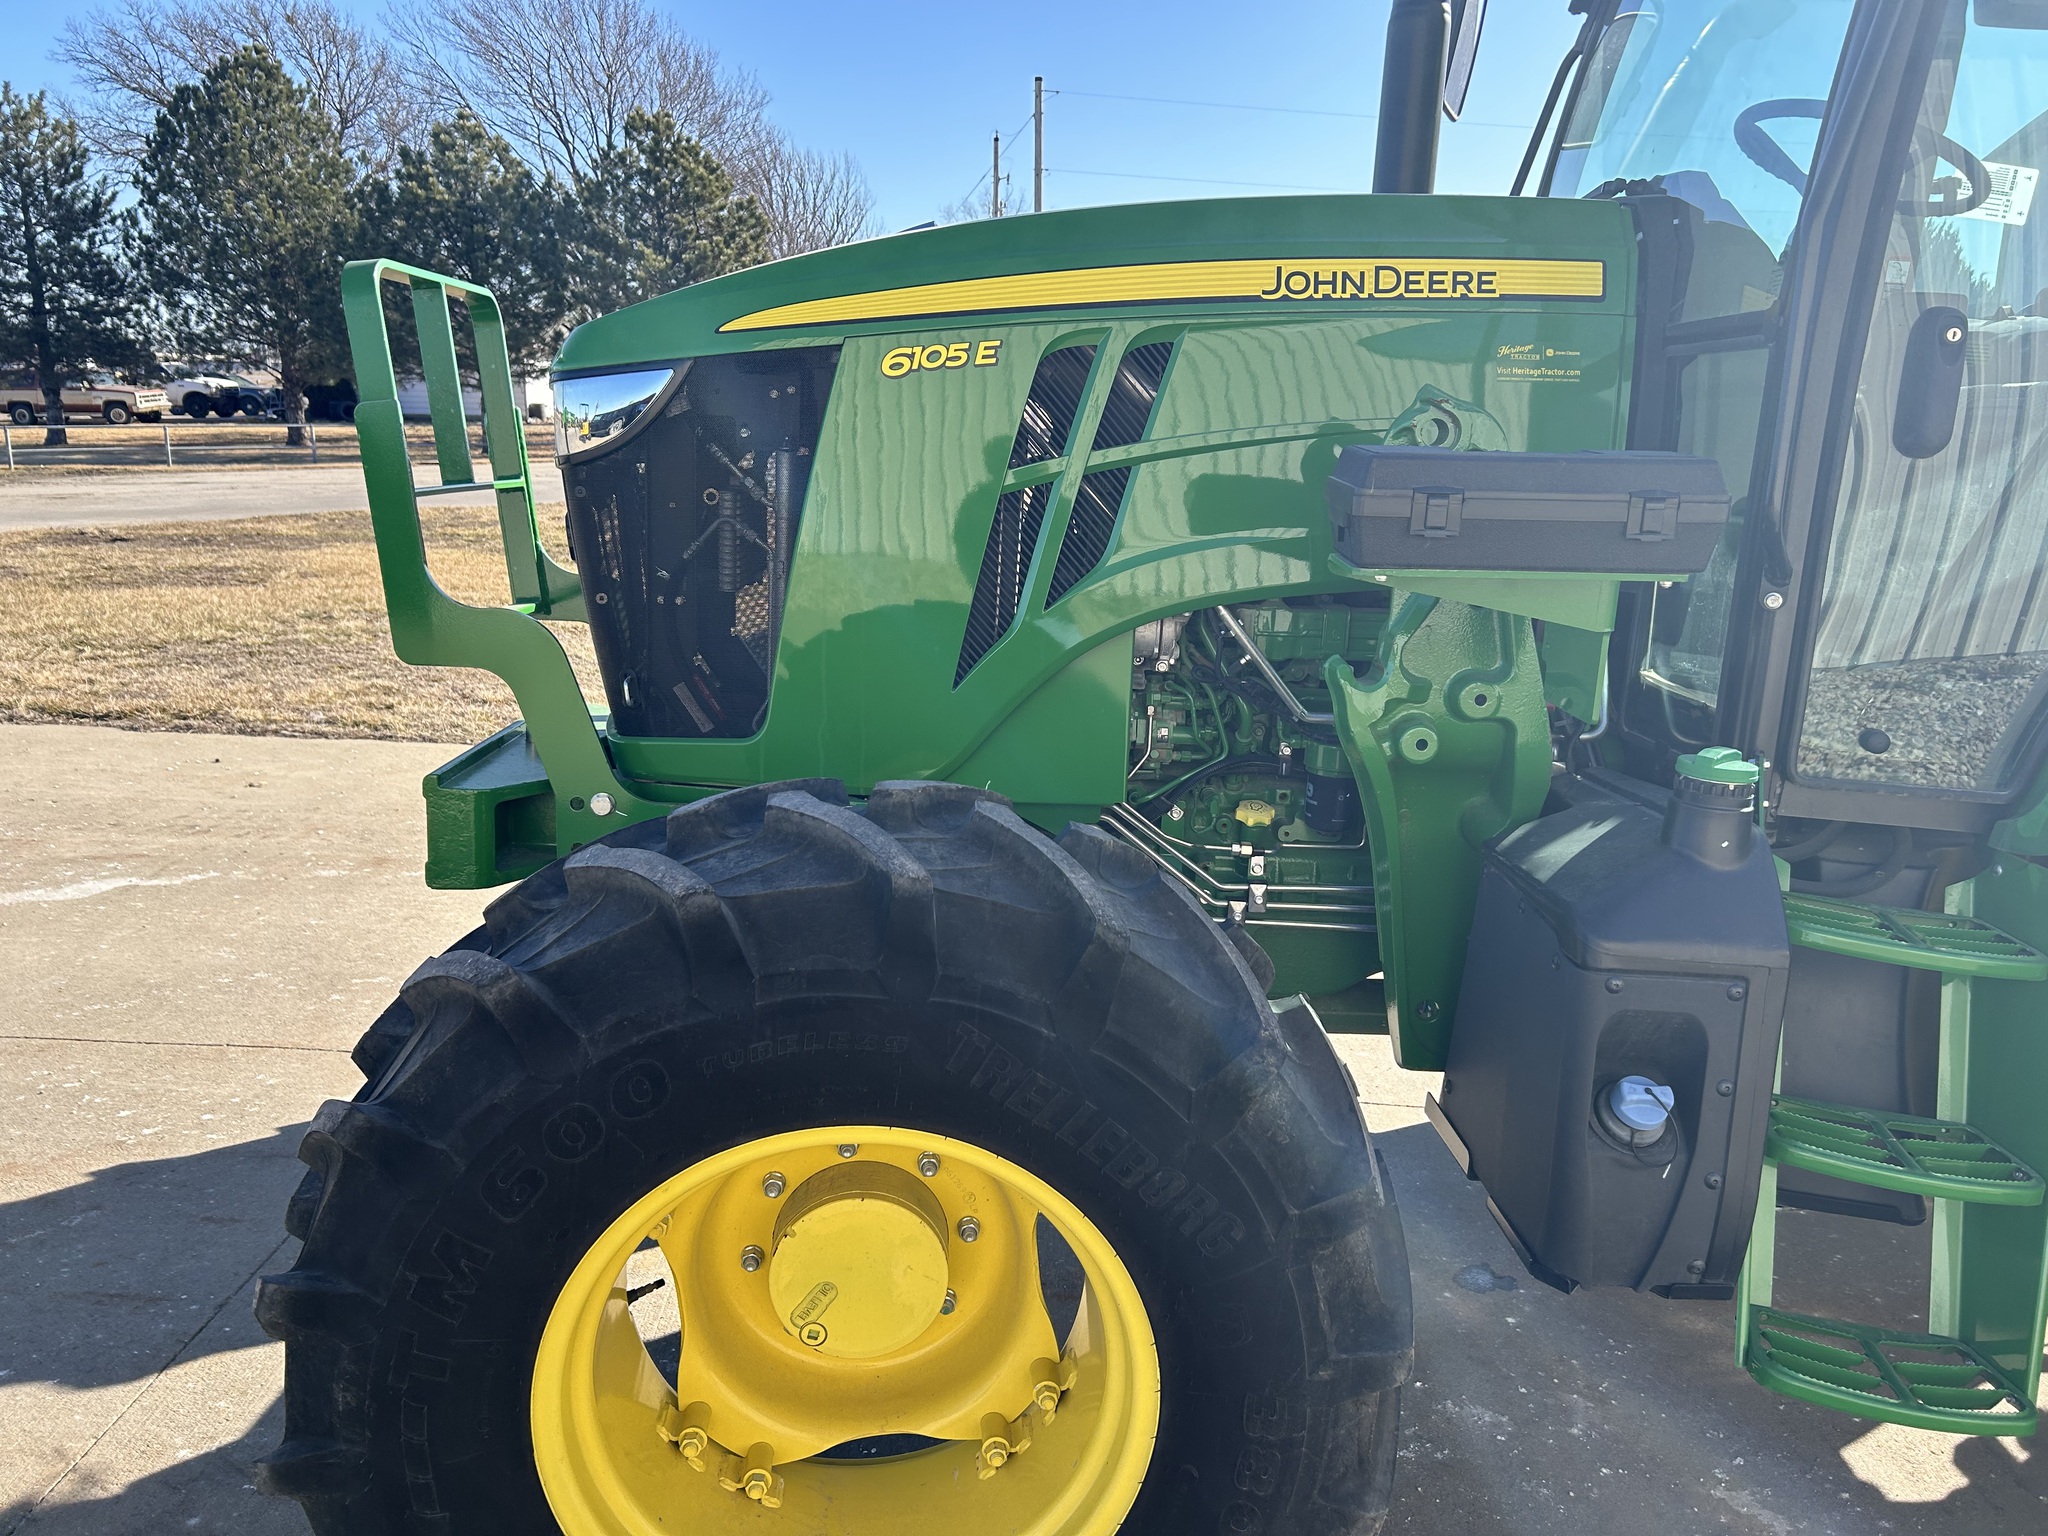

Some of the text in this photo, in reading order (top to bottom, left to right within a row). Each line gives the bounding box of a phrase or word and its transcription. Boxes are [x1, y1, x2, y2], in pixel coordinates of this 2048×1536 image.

[1261, 265, 1500, 298] JOHN DEERE
[881, 339, 1003, 379] 6105 E
[1497, 344, 1534, 358] Heritage
[1497, 367, 1580, 377] Visit HeritageTractor.com
[696, 1031, 911, 1076] TUBELESS
[480, 1058, 672, 1223] 600
[944, 1021, 1246, 1258] TRELLEBORG
[795, 1283, 833, 1321] OIL LEVEL
